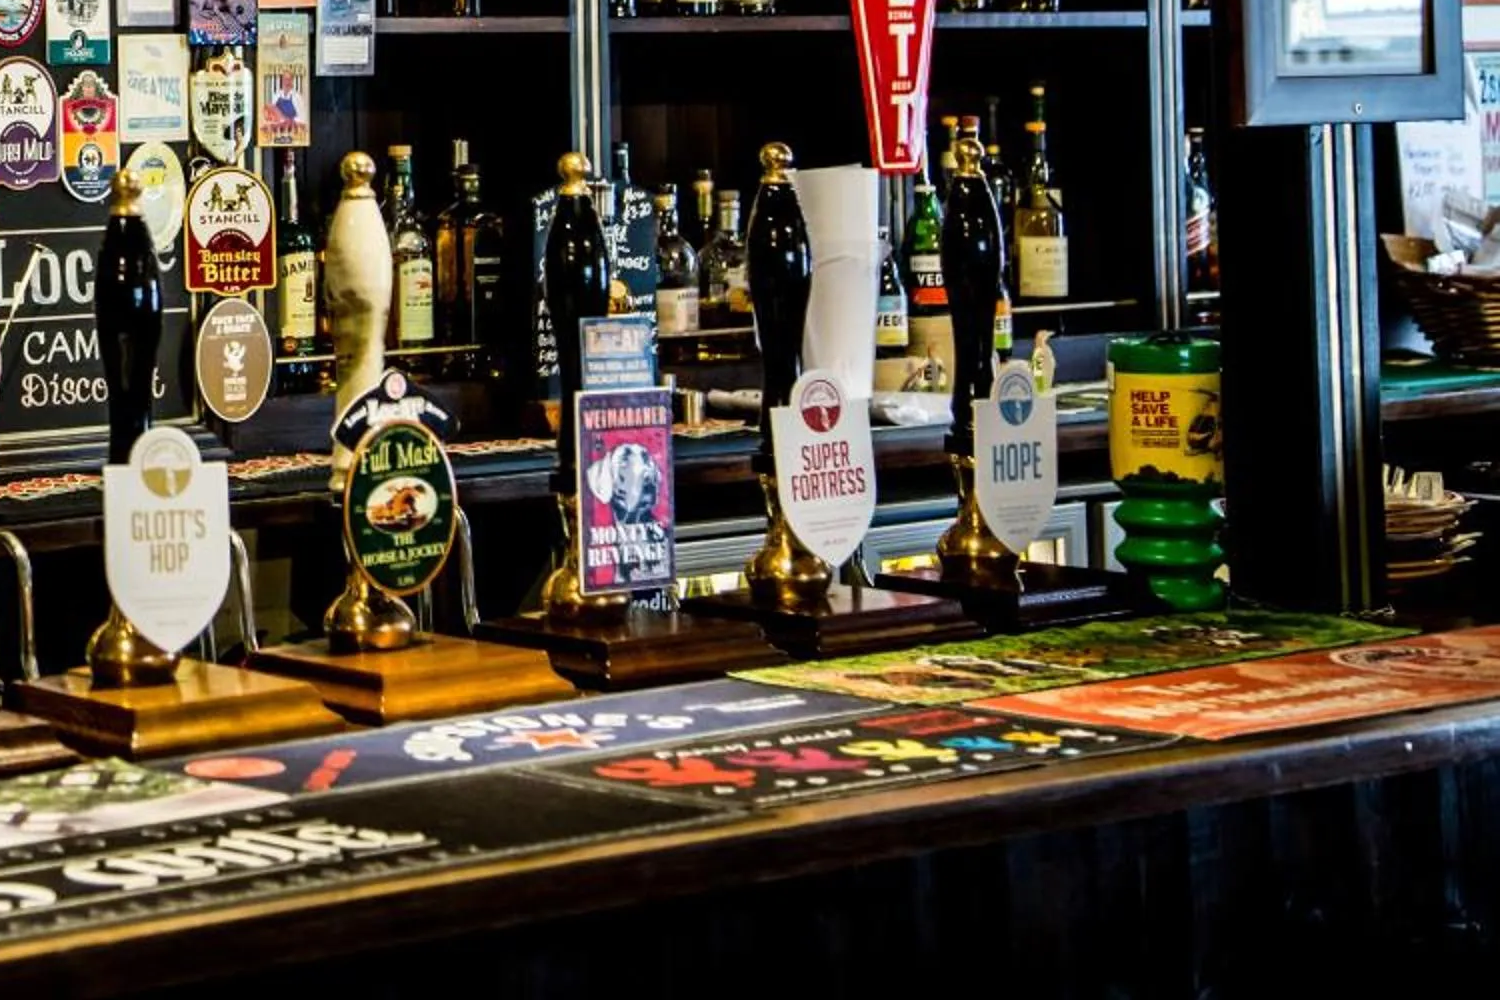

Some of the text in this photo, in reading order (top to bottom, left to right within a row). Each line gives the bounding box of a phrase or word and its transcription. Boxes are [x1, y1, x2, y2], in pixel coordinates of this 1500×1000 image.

[199, 212, 260, 225] STANCILL
[198, 248, 261, 265] Barnsley
[198, 263, 261, 284] Bitter
[22, 328, 100, 366] CAM
[1130, 390, 1171, 403] HELP
[583, 405, 667, 431] WEIMARANER
[1131, 403, 1170, 415] SAVE
[1132, 416, 1178, 427] A LIFE
[396, 438, 440, 470] Mash
[801, 440, 850, 472] SUPER
[992, 440, 1043, 483] HOPE
[790, 466, 867, 502] FORTRESS
[392, 533, 416, 547] THE
[590, 522, 665, 545] MONTY'S
[149, 542, 190, 575] HOP
[588, 544, 667, 568] REVENGE
